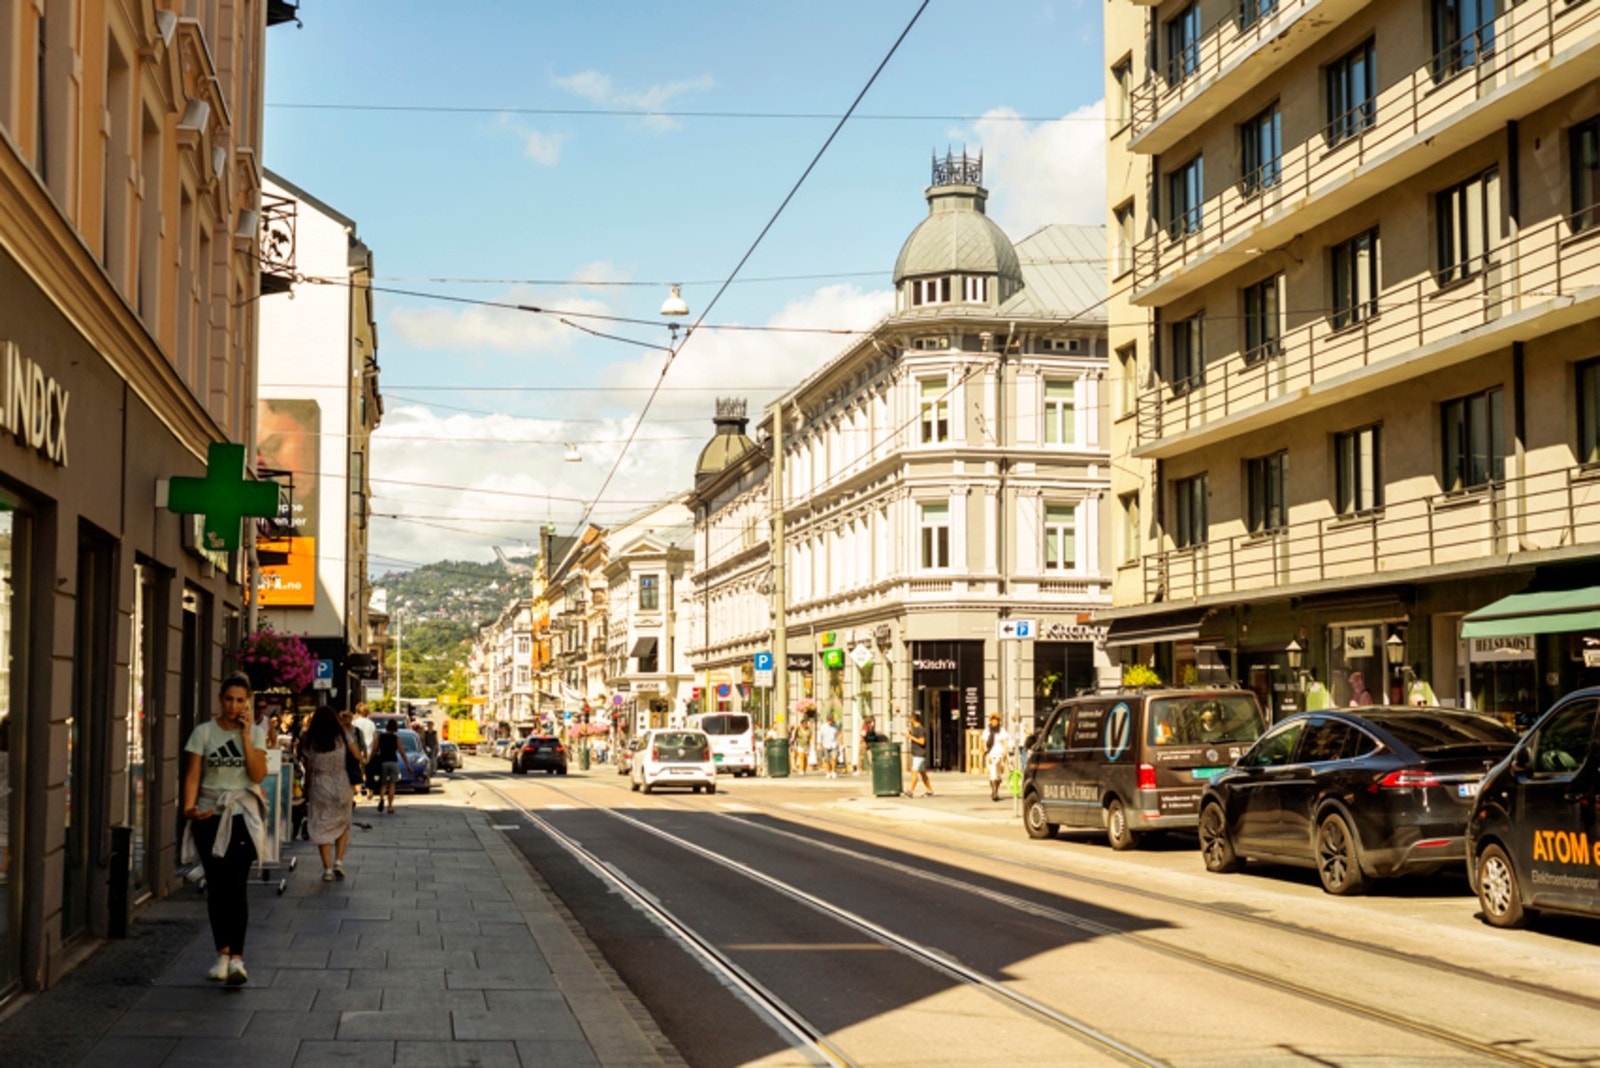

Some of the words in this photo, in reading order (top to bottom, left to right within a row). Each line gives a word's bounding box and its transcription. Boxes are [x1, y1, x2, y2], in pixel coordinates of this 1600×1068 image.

[0, 340, 69, 468] INDEX
[317, 662, 328, 676] P
[758, 655, 769, 668] P
[1533, 829, 1590, 866] ATOM
